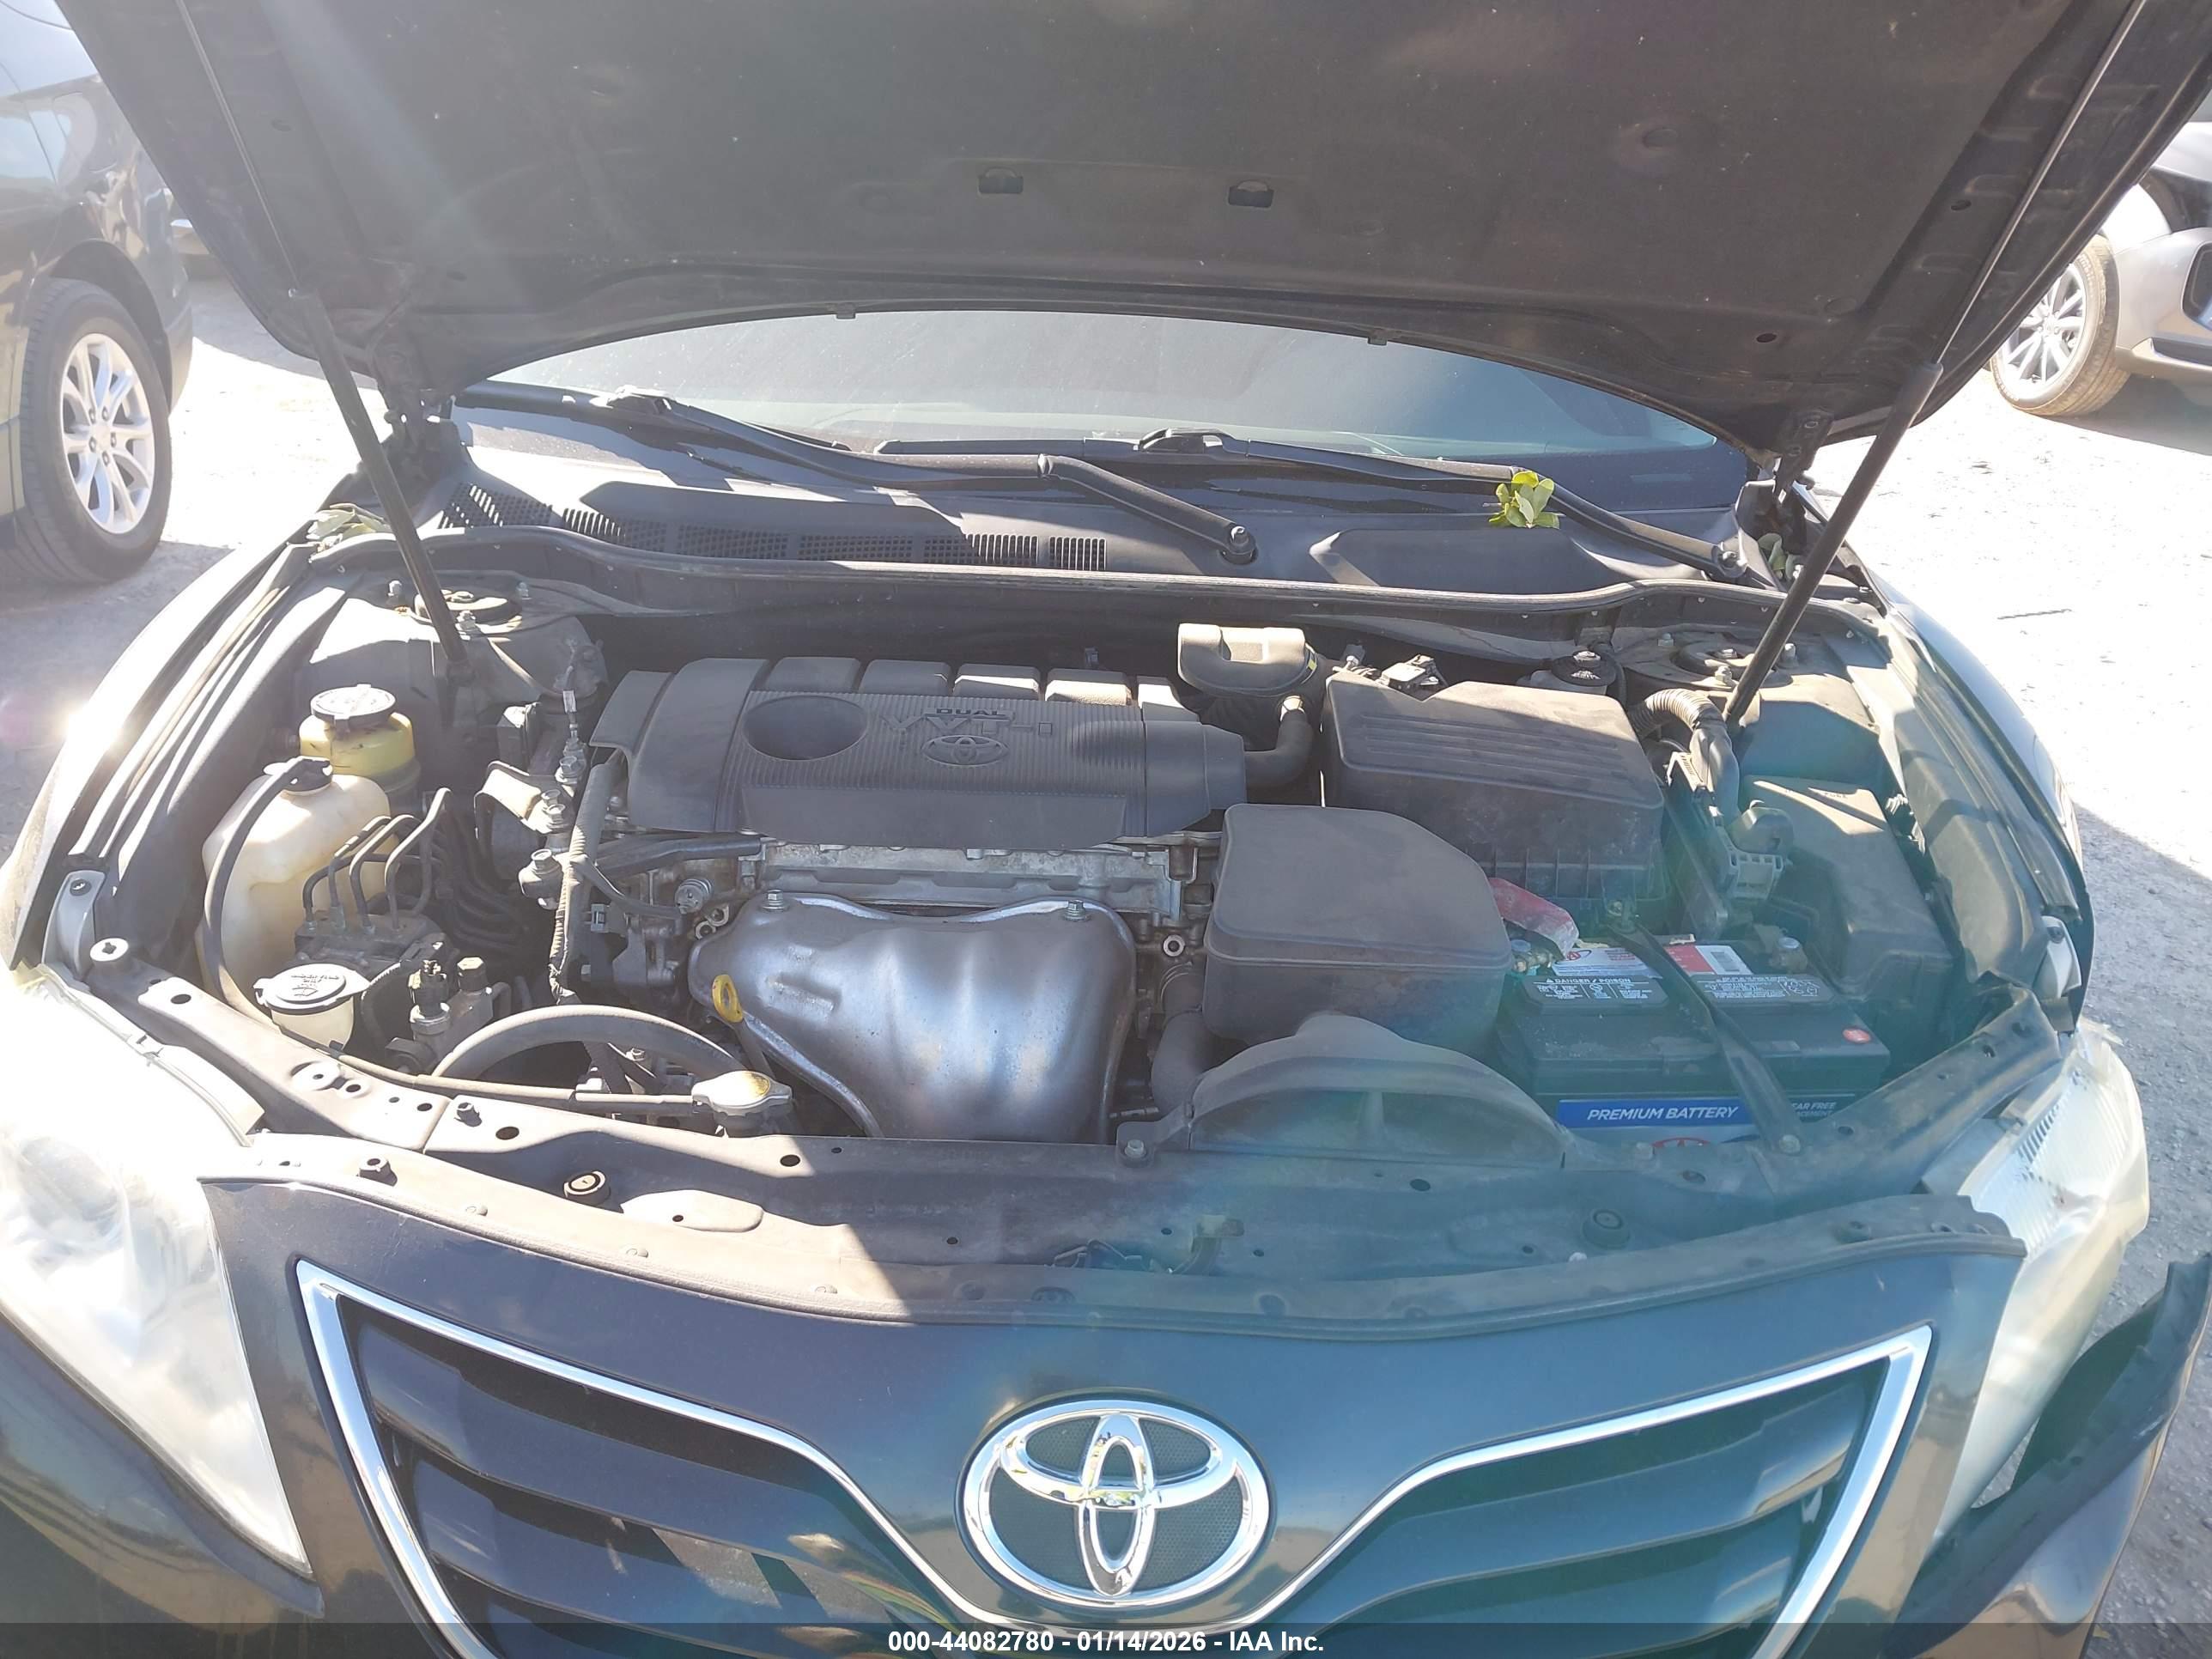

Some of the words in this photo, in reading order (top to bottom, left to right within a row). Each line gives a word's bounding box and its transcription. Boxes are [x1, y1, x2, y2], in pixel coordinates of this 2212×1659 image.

[936, 708, 1006, 717] DUAL
[1810, 1101, 1837, 1110] FREE
[1587, 1107, 1664, 1121] PREMIUM
[1665, 1106, 1739, 1120] BATTERY
